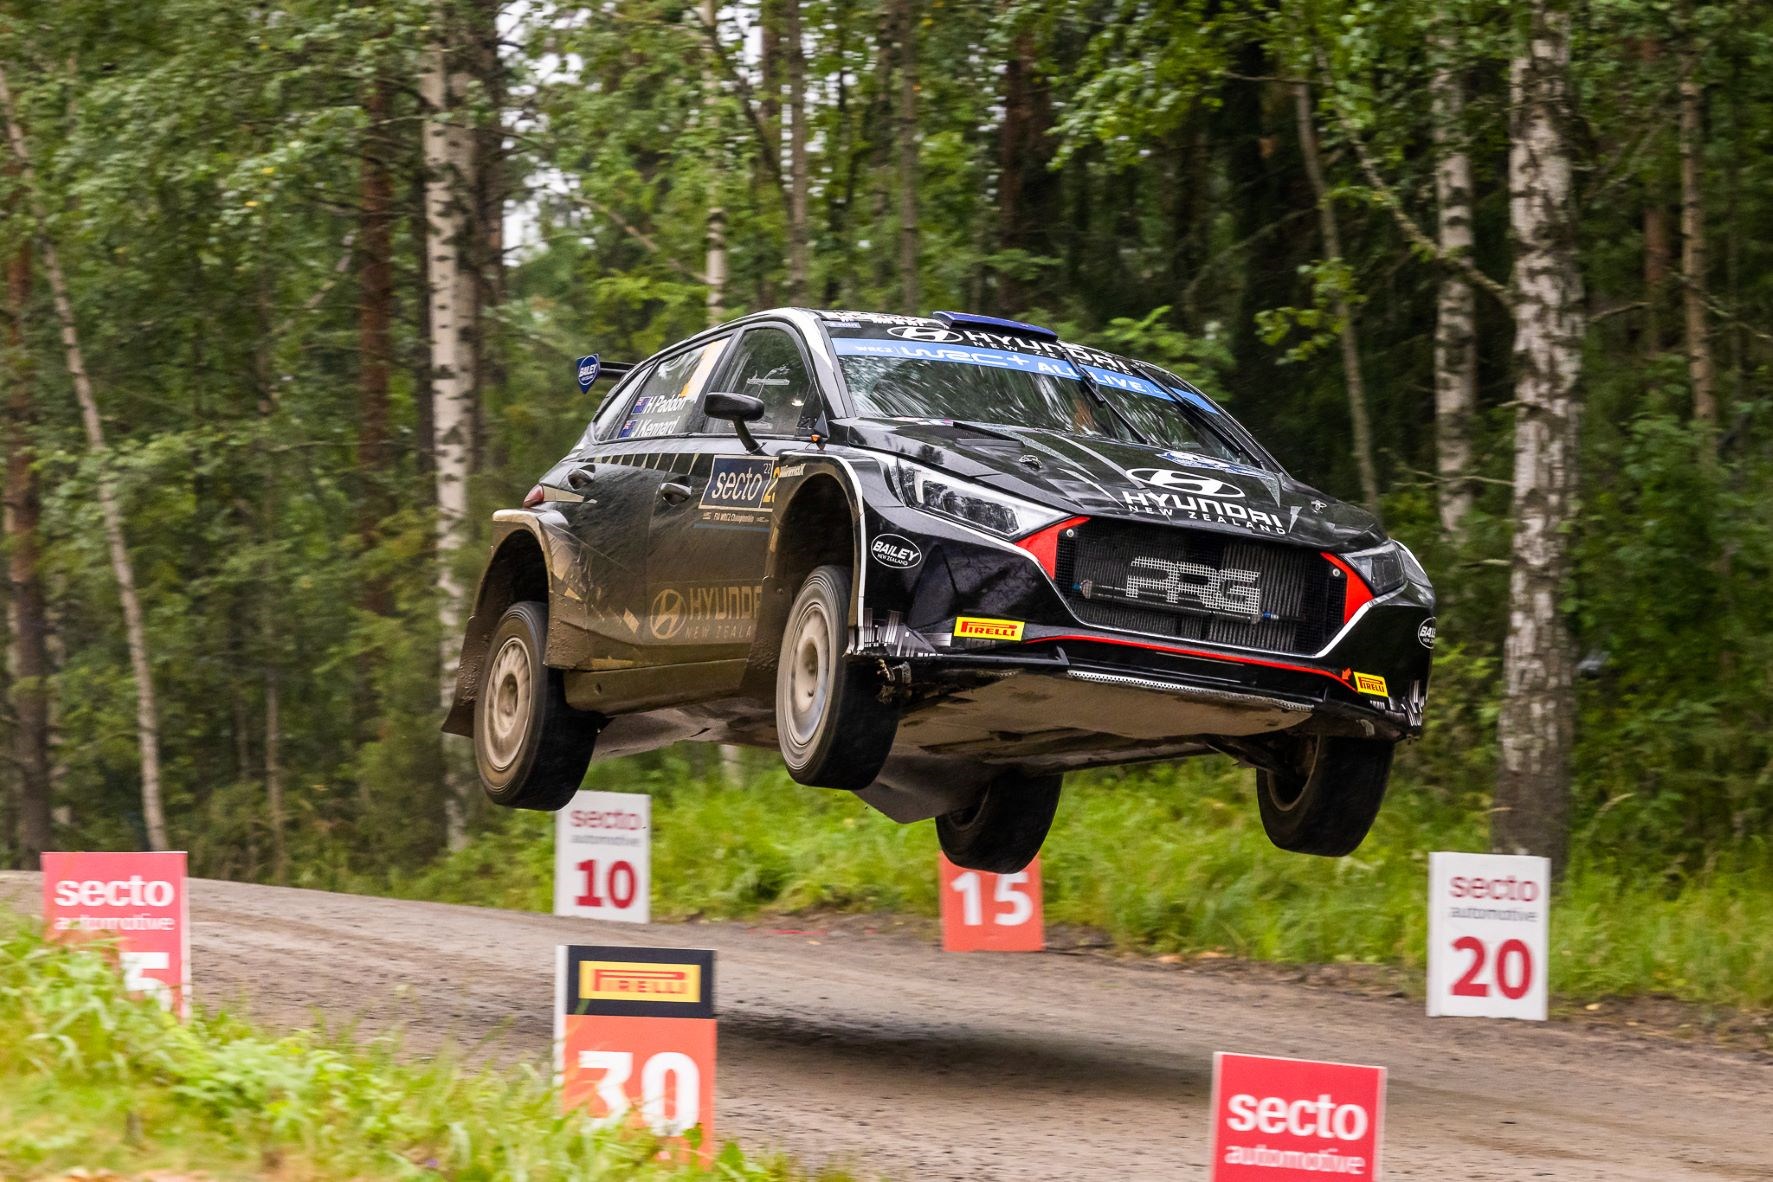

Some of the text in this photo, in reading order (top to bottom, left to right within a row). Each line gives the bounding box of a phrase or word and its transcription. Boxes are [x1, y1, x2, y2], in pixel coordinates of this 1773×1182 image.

[963, 330, 1130, 371] HYUNDAI
[974, 341, 1018, 352] NEW
[1033, 350, 1133, 376] ZELAND
[1088, 371, 1147, 393] LIVE
[642, 393, 687, 414] H Paddon
[637, 415, 680, 438] Kennard
[711, 466, 763, 500] secto
[763, 466, 780, 503] 2
[1122, 490, 1283, 528] HYUNDAI
[1128, 504, 1286, 535] NEW ZEALAND
[872, 540, 919, 562] BAILEY
[689, 585, 762, 621] HYUNDA
[685, 625, 752, 640] NEW ZEALA
[960, 621, 1018, 637] PIRELLI
[1358, 676, 1385, 693] PIRELLI
[53, 875, 175, 907] secto
[574, 859, 637, 910] 10
[950, 870, 1034, 926] 15
[1449, 875, 1541, 902] secto
[592, 968, 688, 995] PIRELLI
[1450, 935, 1535, 1001] 20
[578, 1050, 701, 1138] 30
[1226, 1093, 1369, 1141] secto
[1223, 1144, 1367, 1175] automotive
